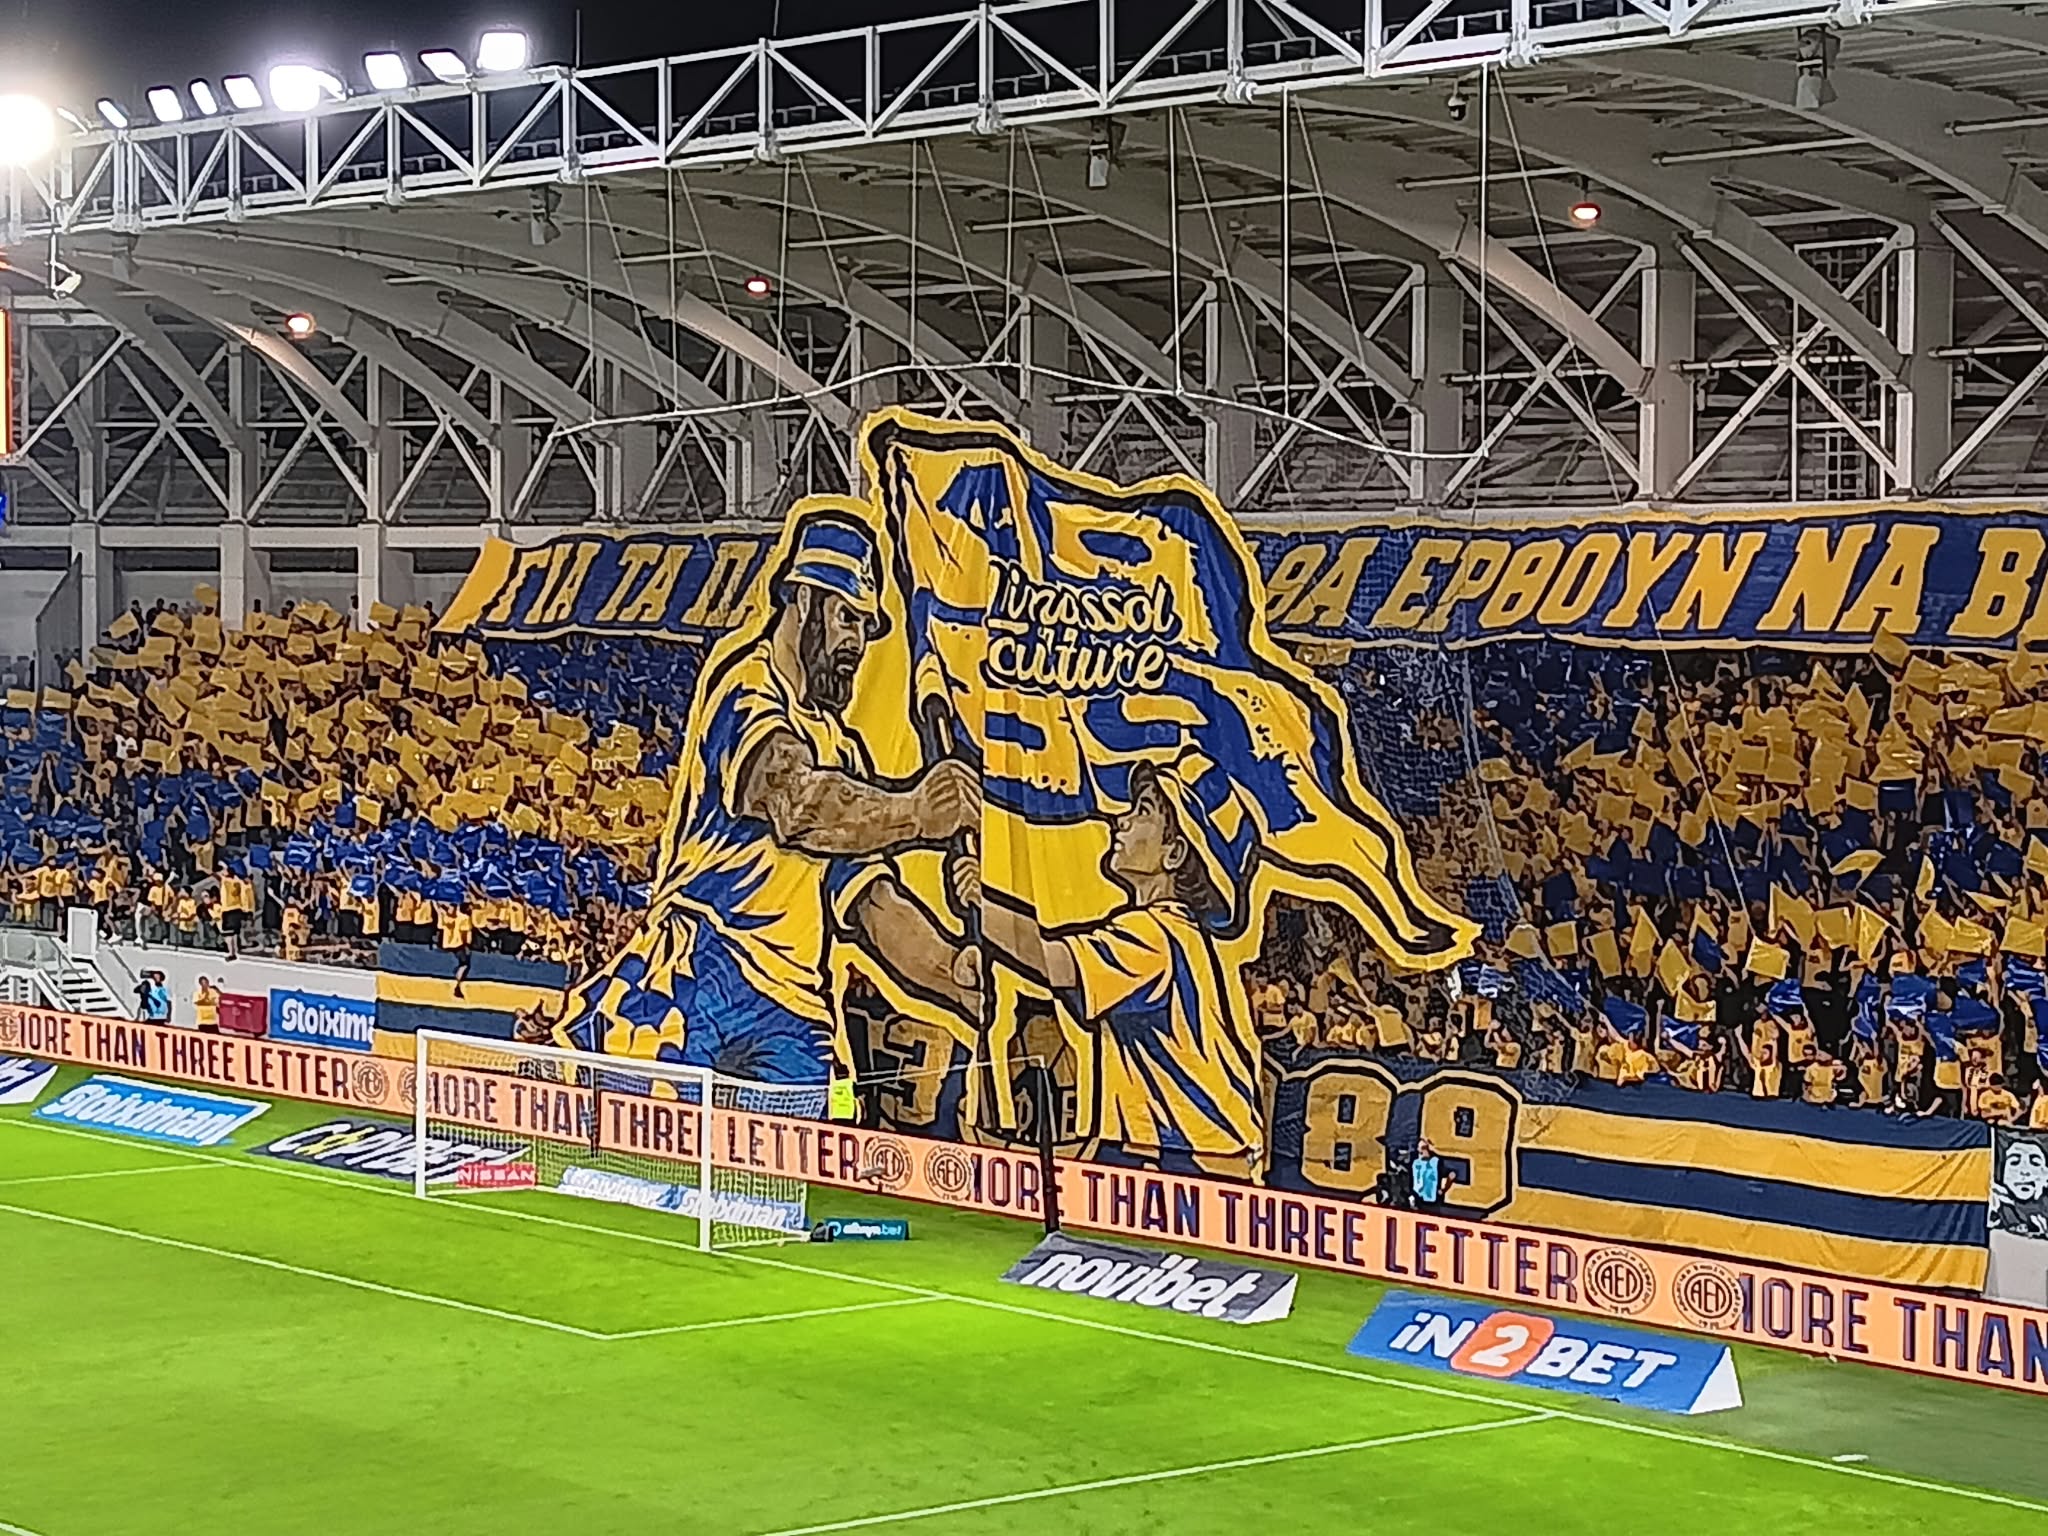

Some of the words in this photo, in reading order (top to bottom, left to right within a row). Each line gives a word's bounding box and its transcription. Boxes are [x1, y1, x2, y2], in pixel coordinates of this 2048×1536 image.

[81, 1020, 147, 1068] THAN
[155, 1031, 236, 1083] THREE
[1300, 1064, 1515, 1210] 89
[458, 1167, 535, 1183] NISSAN
[1082, 1170, 1200, 1238] THAN
[1218, 1188, 1366, 1267] THREE
[1020, 1253, 1261, 1317] novibet
[1893, 1296, 2048, 1383] THAN
